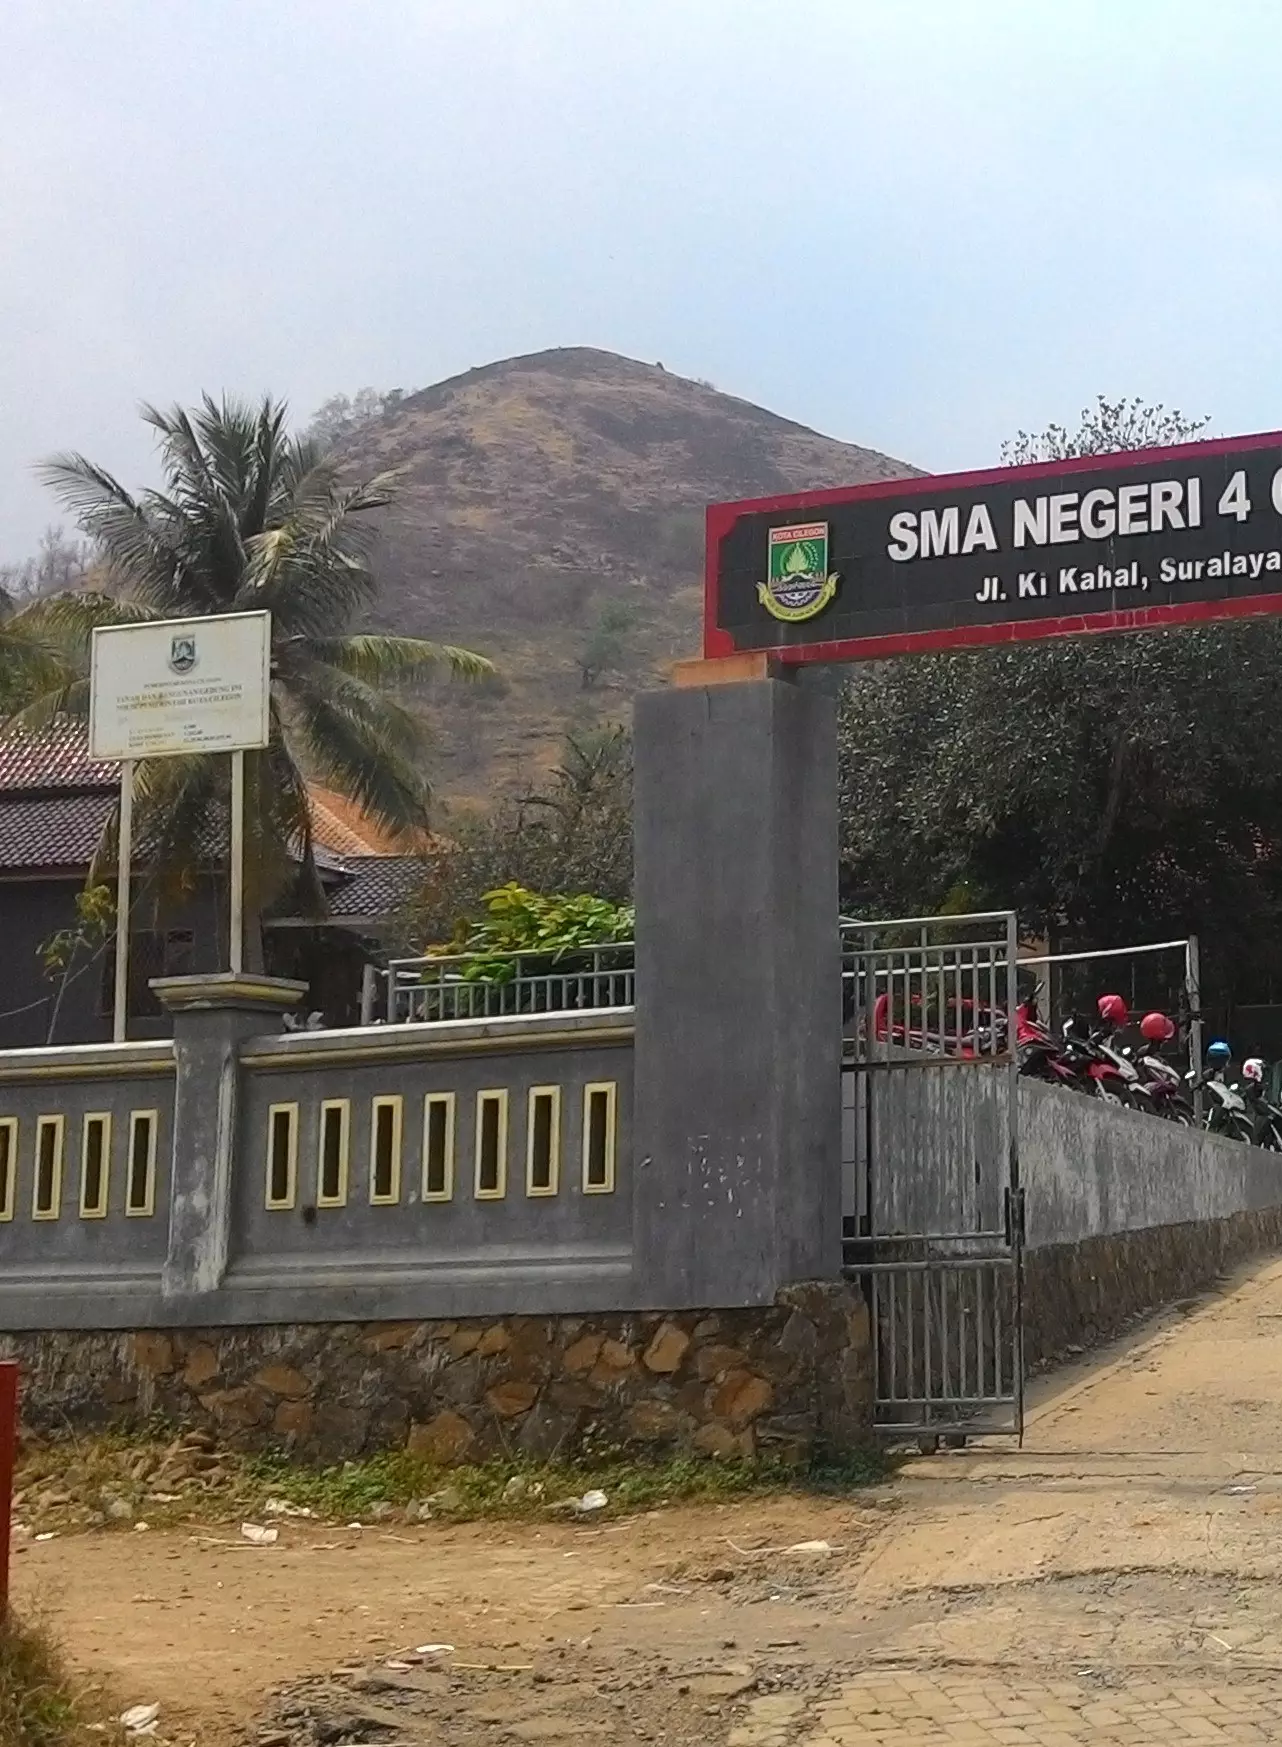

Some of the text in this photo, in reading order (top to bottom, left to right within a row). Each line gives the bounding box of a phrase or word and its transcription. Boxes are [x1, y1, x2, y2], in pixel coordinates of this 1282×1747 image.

[886, 502, 999, 562] SMA
[1012, 476, 1201, 549] NEGERI
[1217, 470, 1252, 523] 4
[975, 576, 1007, 602] Jl.
[1018, 572, 1048, 598] Ki
[1059, 561, 1149, 594] Kahal,
